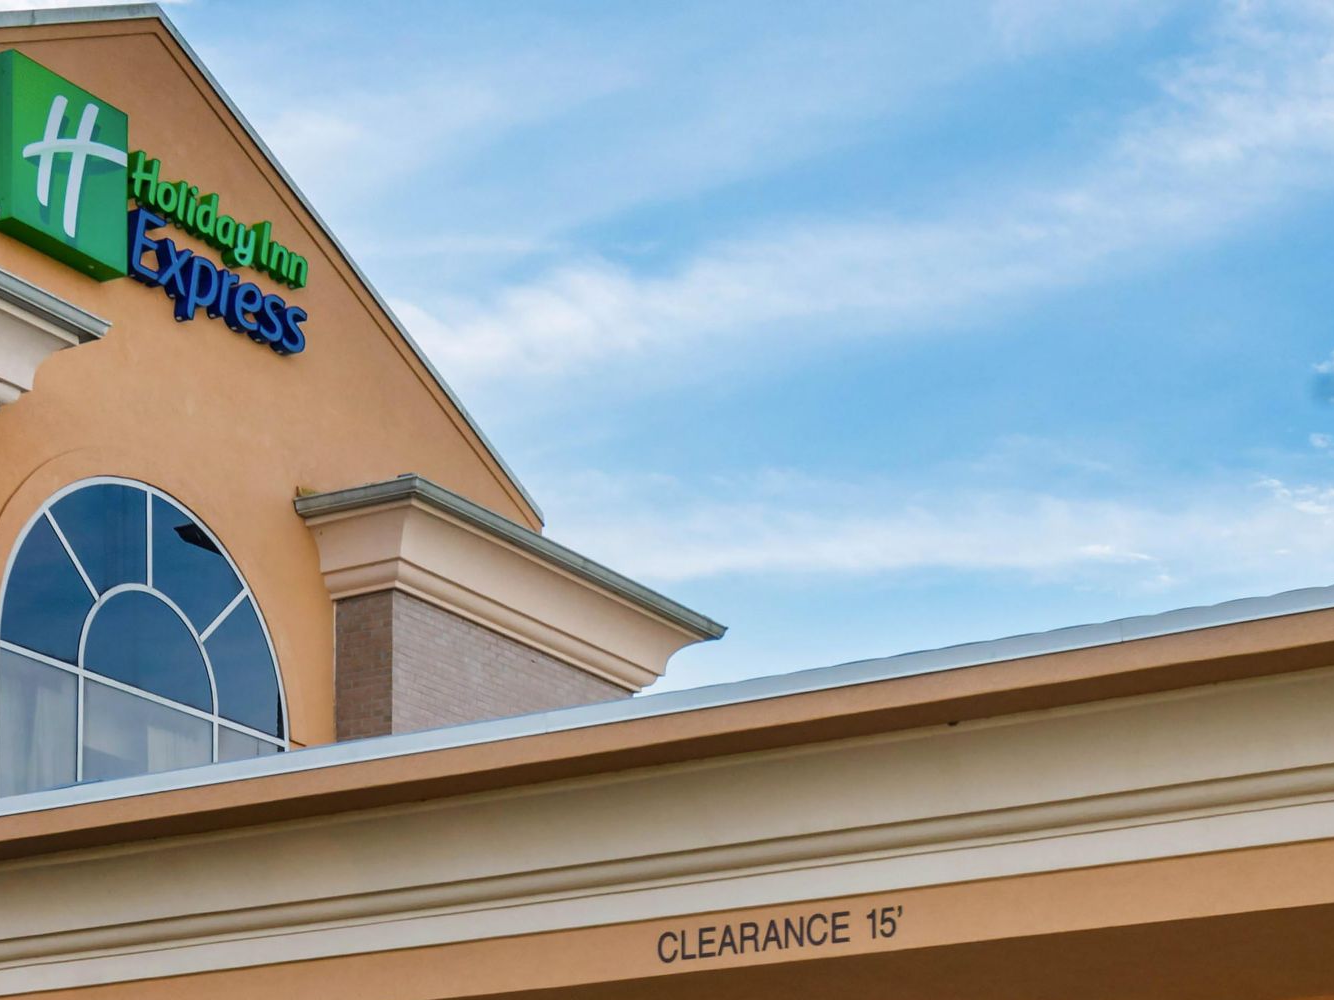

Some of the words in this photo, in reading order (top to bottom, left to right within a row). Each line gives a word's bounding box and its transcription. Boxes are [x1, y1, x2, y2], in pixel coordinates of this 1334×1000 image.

[129, 208, 308, 354] Express
[130, 150, 256, 267] Holiday
[257, 220, 309, 288] Inn
[657, 911, 851, 963] CLEARANCE
[866, 905, 903, 940] 15'
